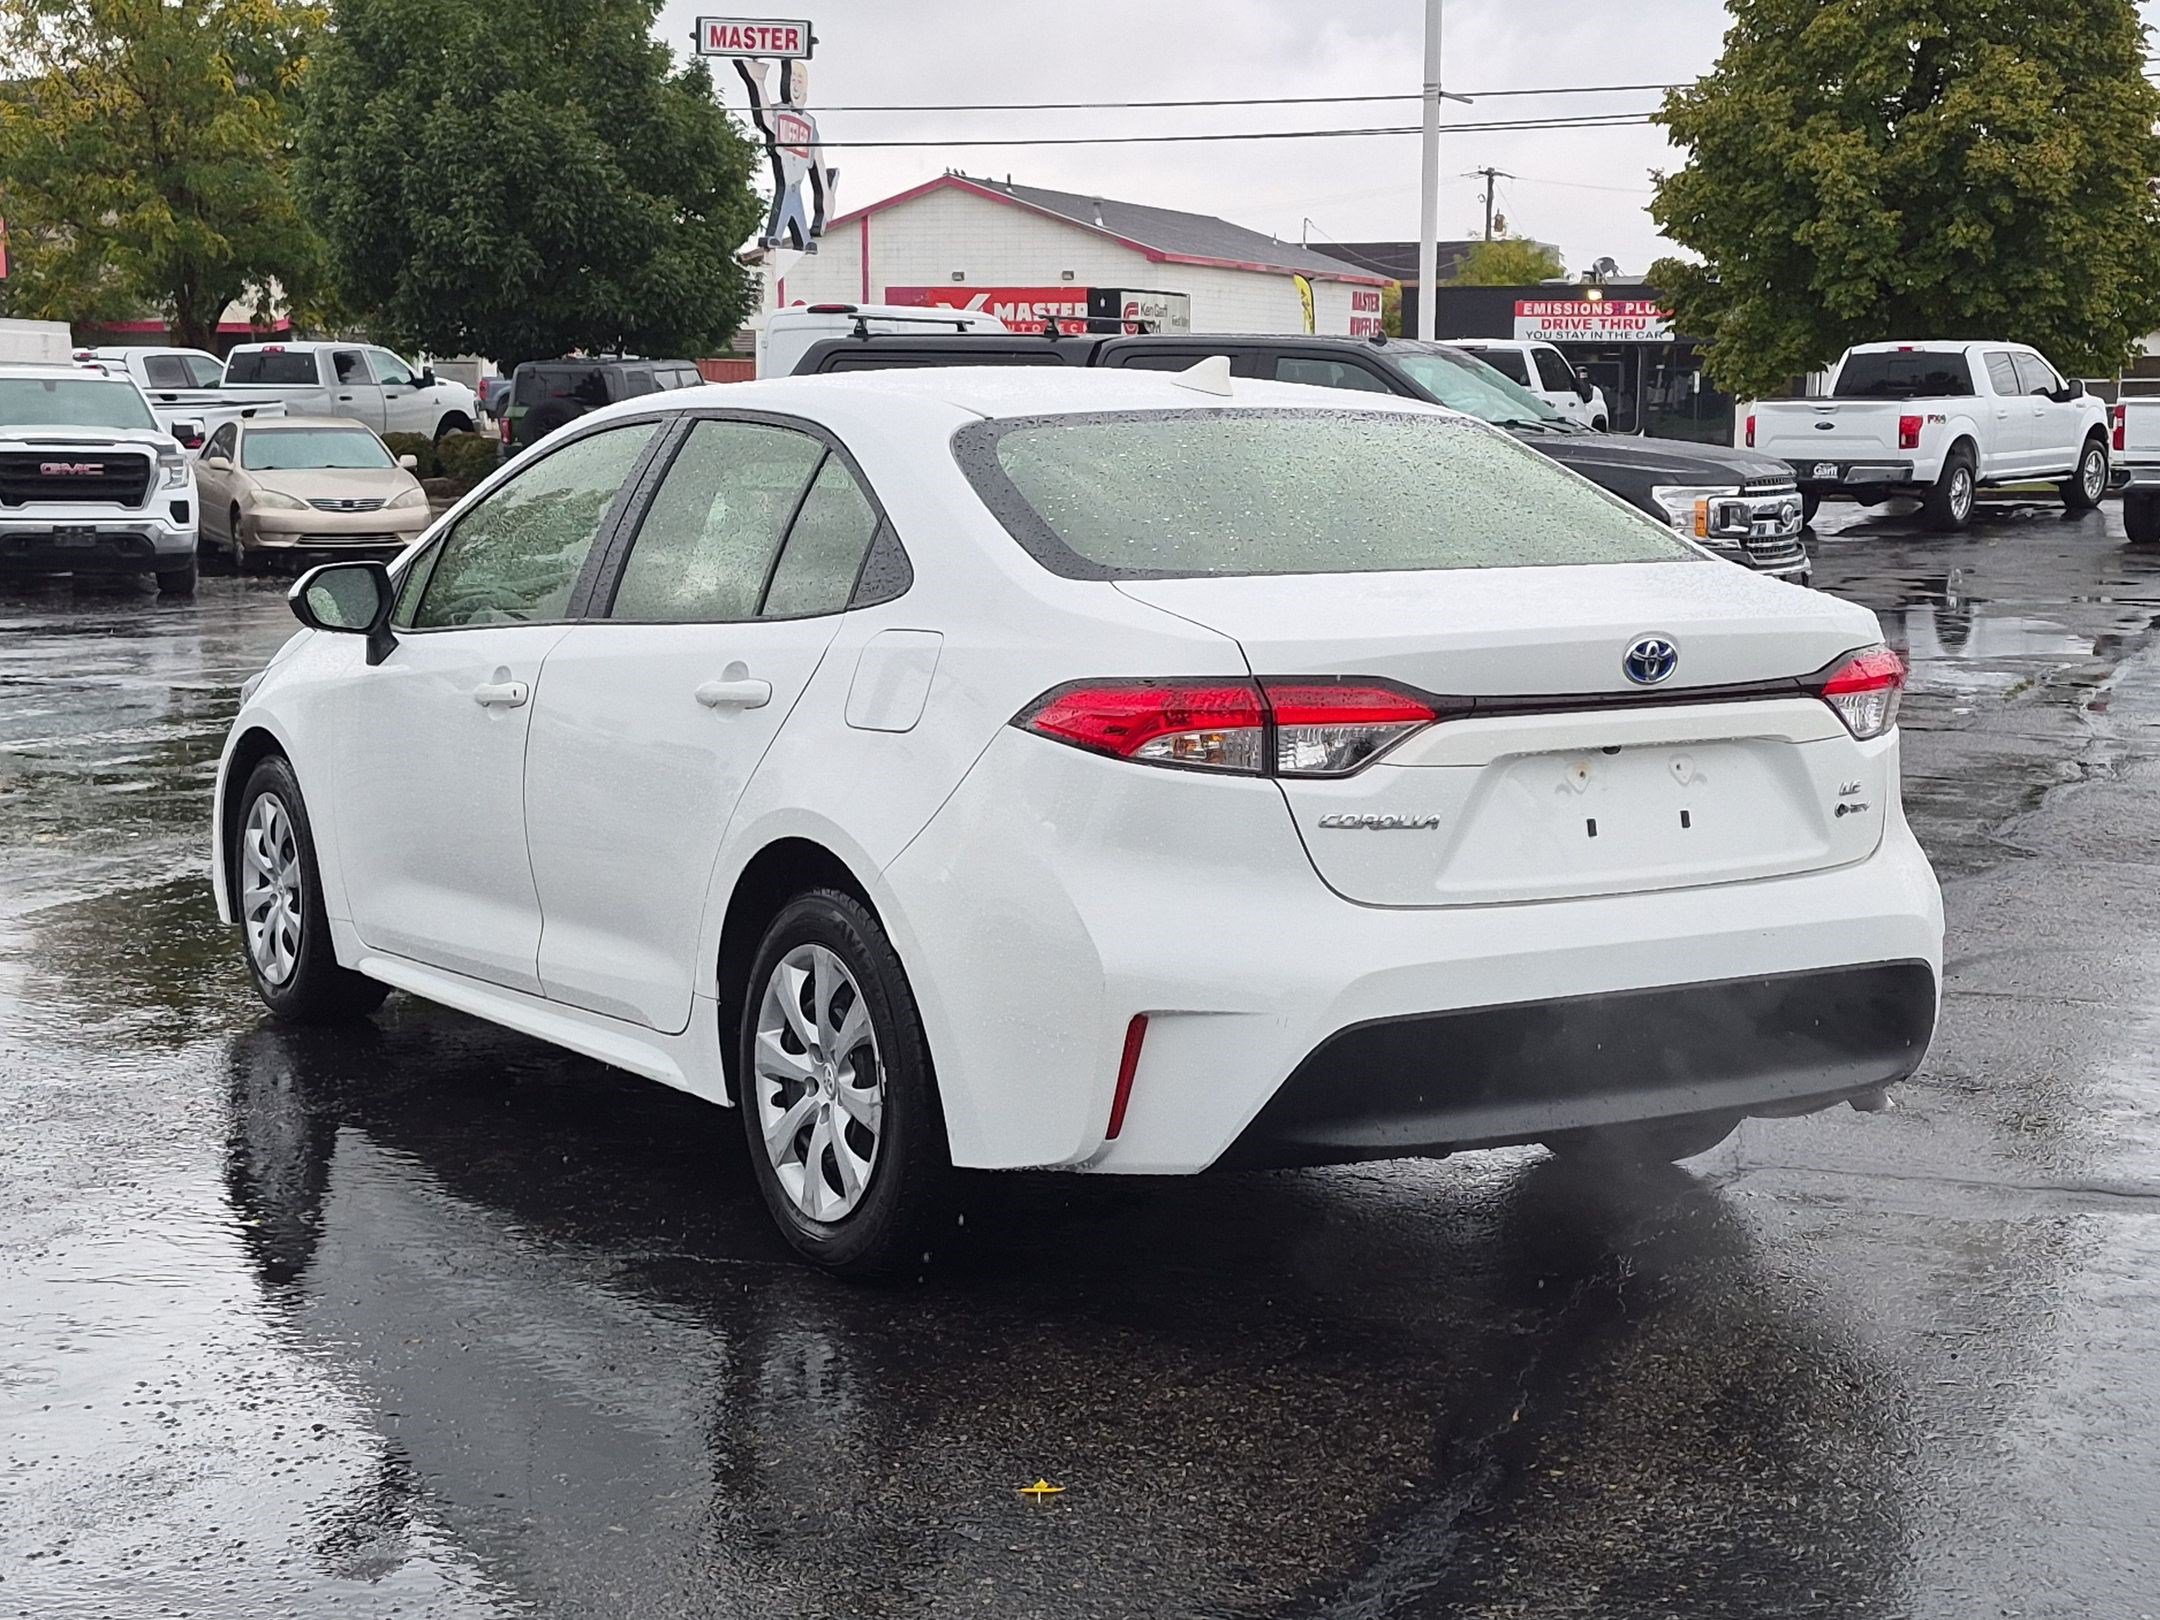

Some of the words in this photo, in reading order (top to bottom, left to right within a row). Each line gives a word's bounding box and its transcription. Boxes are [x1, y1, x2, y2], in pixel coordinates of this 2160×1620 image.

[710, 25, 798, 51] MASTER
[1351, 291, 1380, 312] MASTER
[1523, 302, 1614, 316] EMISSIONS
[1625, 302, 1661, 316] PLU
[993, 302, 1088, 321] MASTER
[1541, 318, 1593, 331] DRIVE
[1599, 318, 1647, 331] THRU
[1525, 331, 1556, 340] YOU
[1557, 331, 1587, 340] STAY
[1590, 331, 1603, 340] IN
[1606, 331, 1633, 340] THE
[1635, 331, 1664, 340] CAR
[40, 462, 104, 476] GMC
[1838, 781, 1862, 797] LE
[1318, 814, 1440, 831] COROLLA
